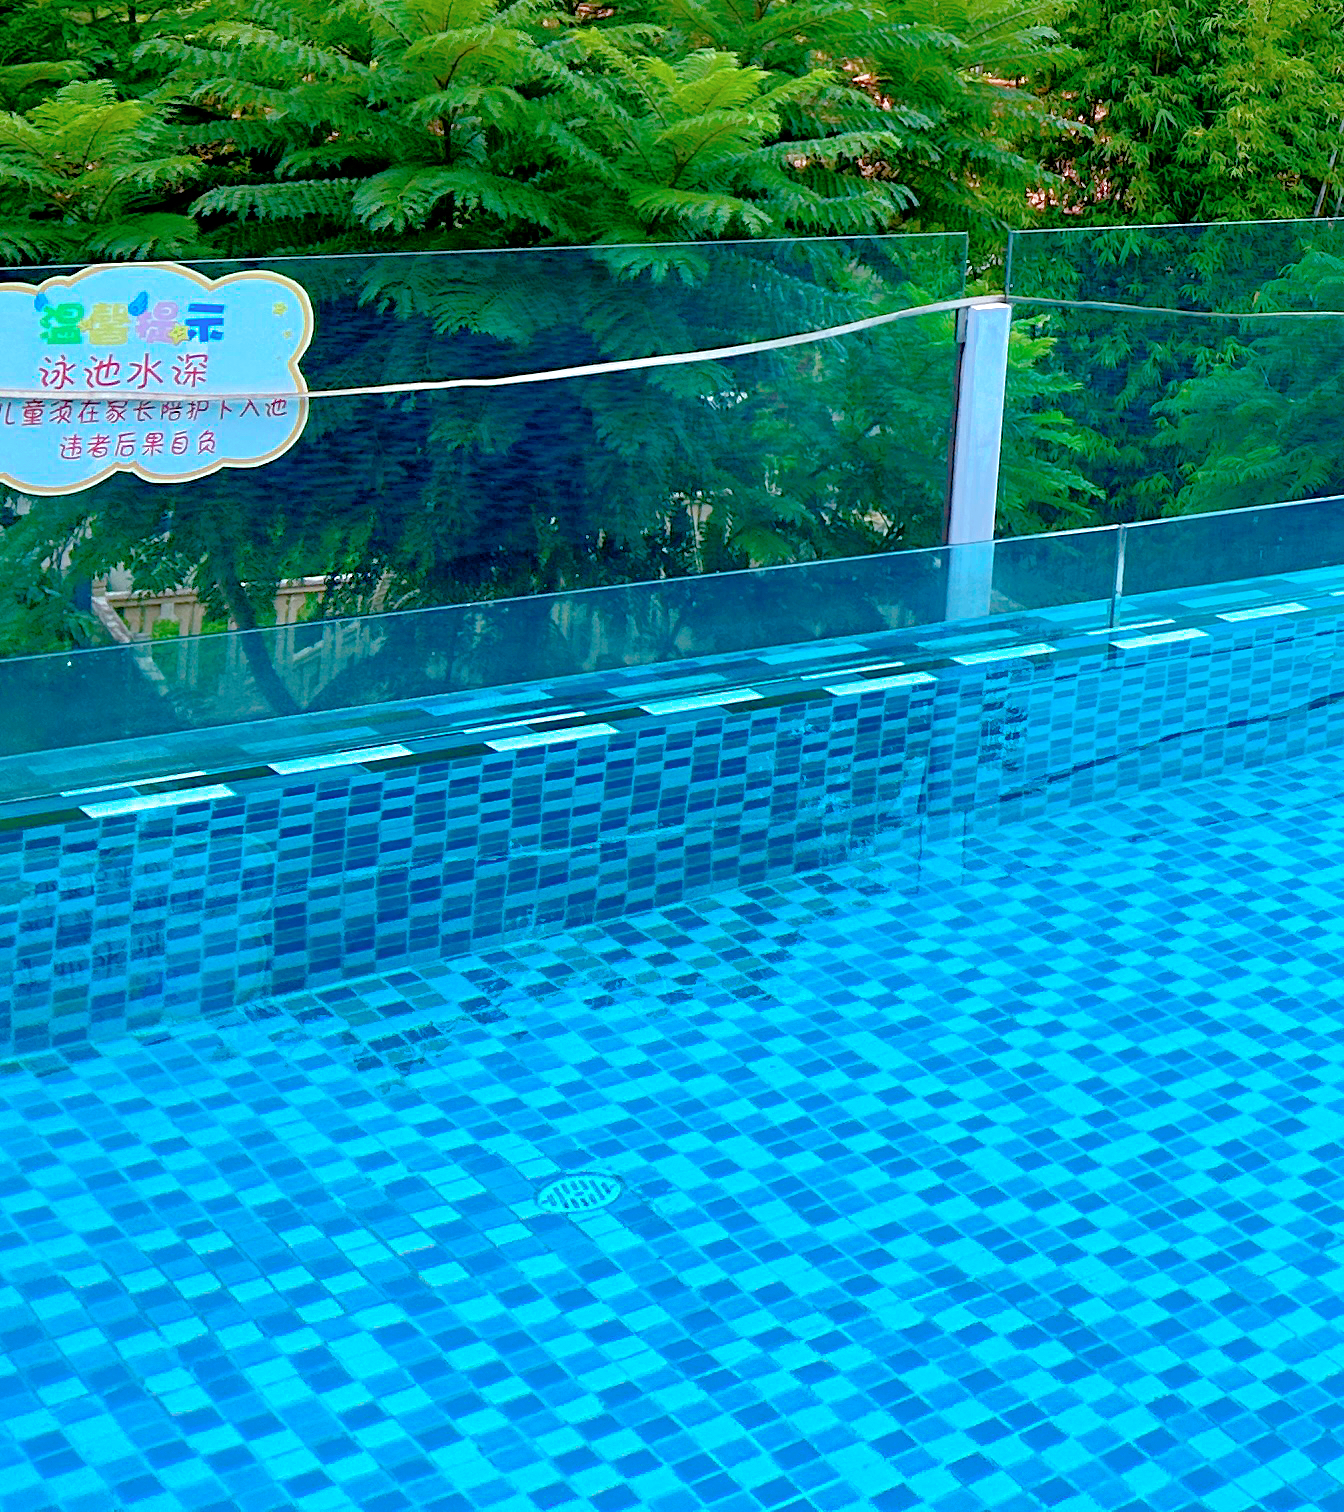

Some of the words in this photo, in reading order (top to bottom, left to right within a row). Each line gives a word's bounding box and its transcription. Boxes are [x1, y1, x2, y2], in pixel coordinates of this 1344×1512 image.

[39, 353, 209, 390] 泳池水深
[59, 430, 216, 460] 违者后果自负
